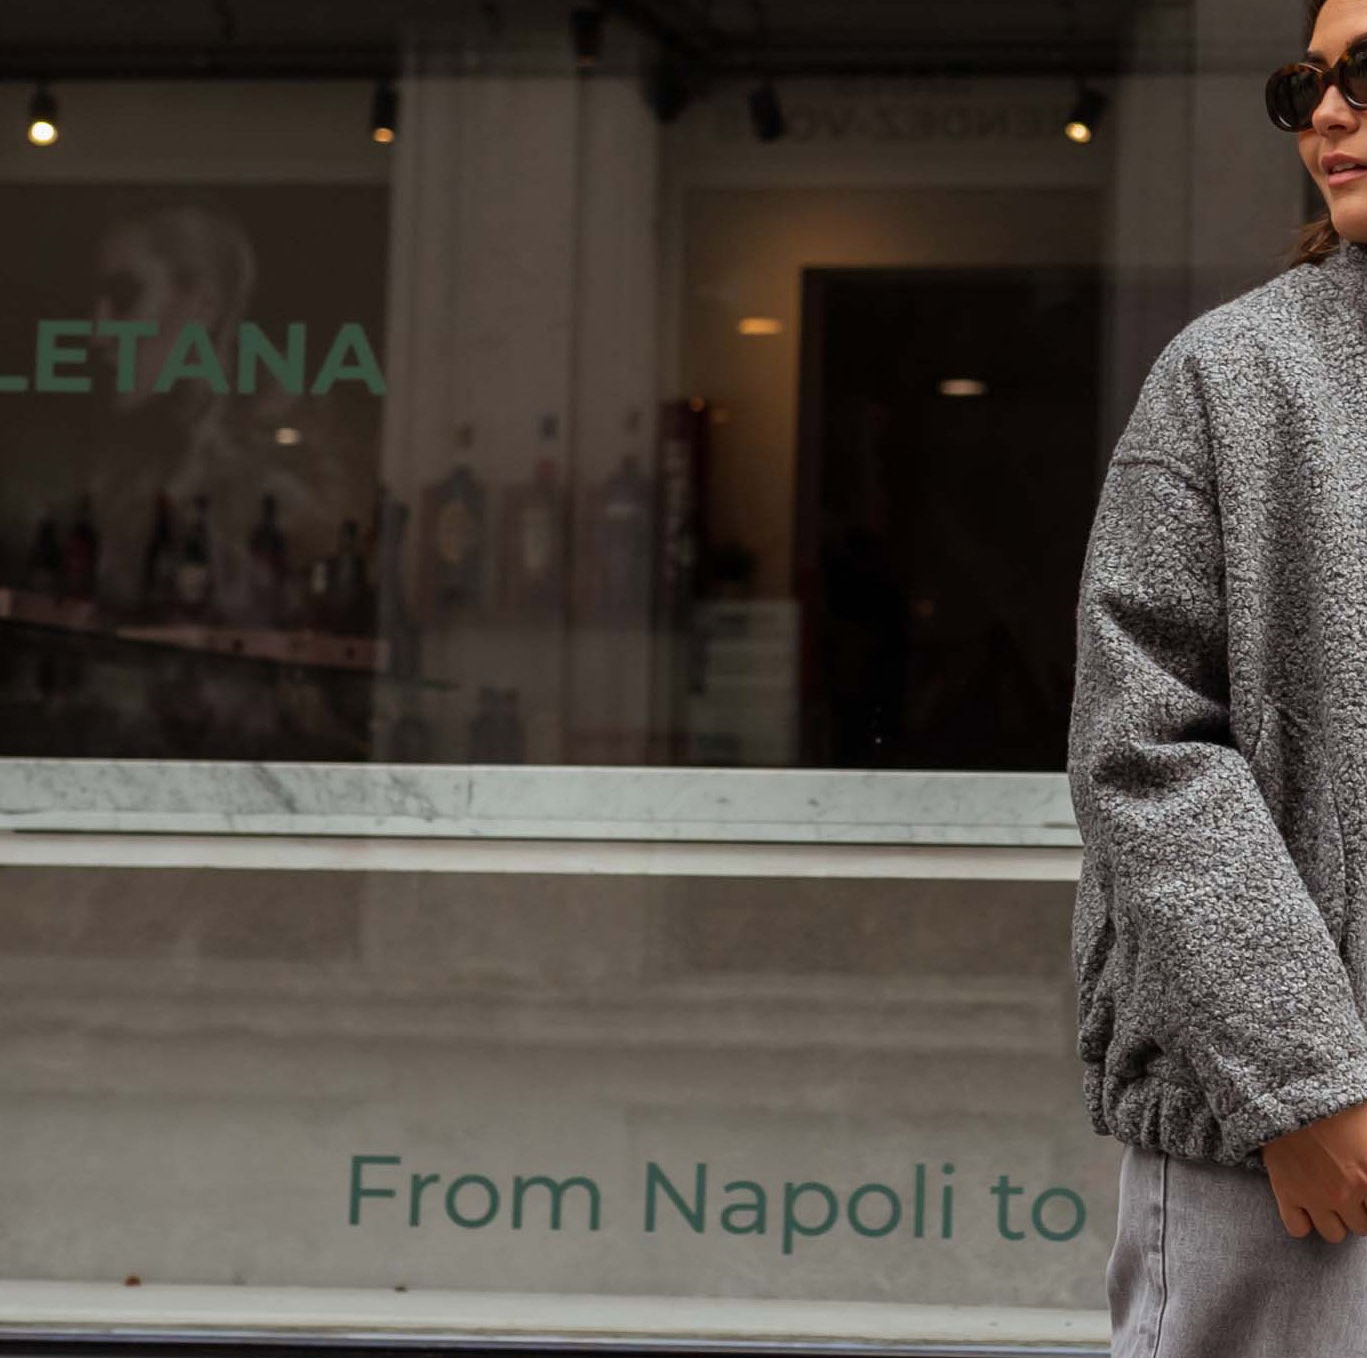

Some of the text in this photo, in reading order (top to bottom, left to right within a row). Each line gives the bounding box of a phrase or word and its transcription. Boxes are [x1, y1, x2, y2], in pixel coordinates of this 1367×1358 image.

[350, 1155, 1087, 1256] From Napoli to
